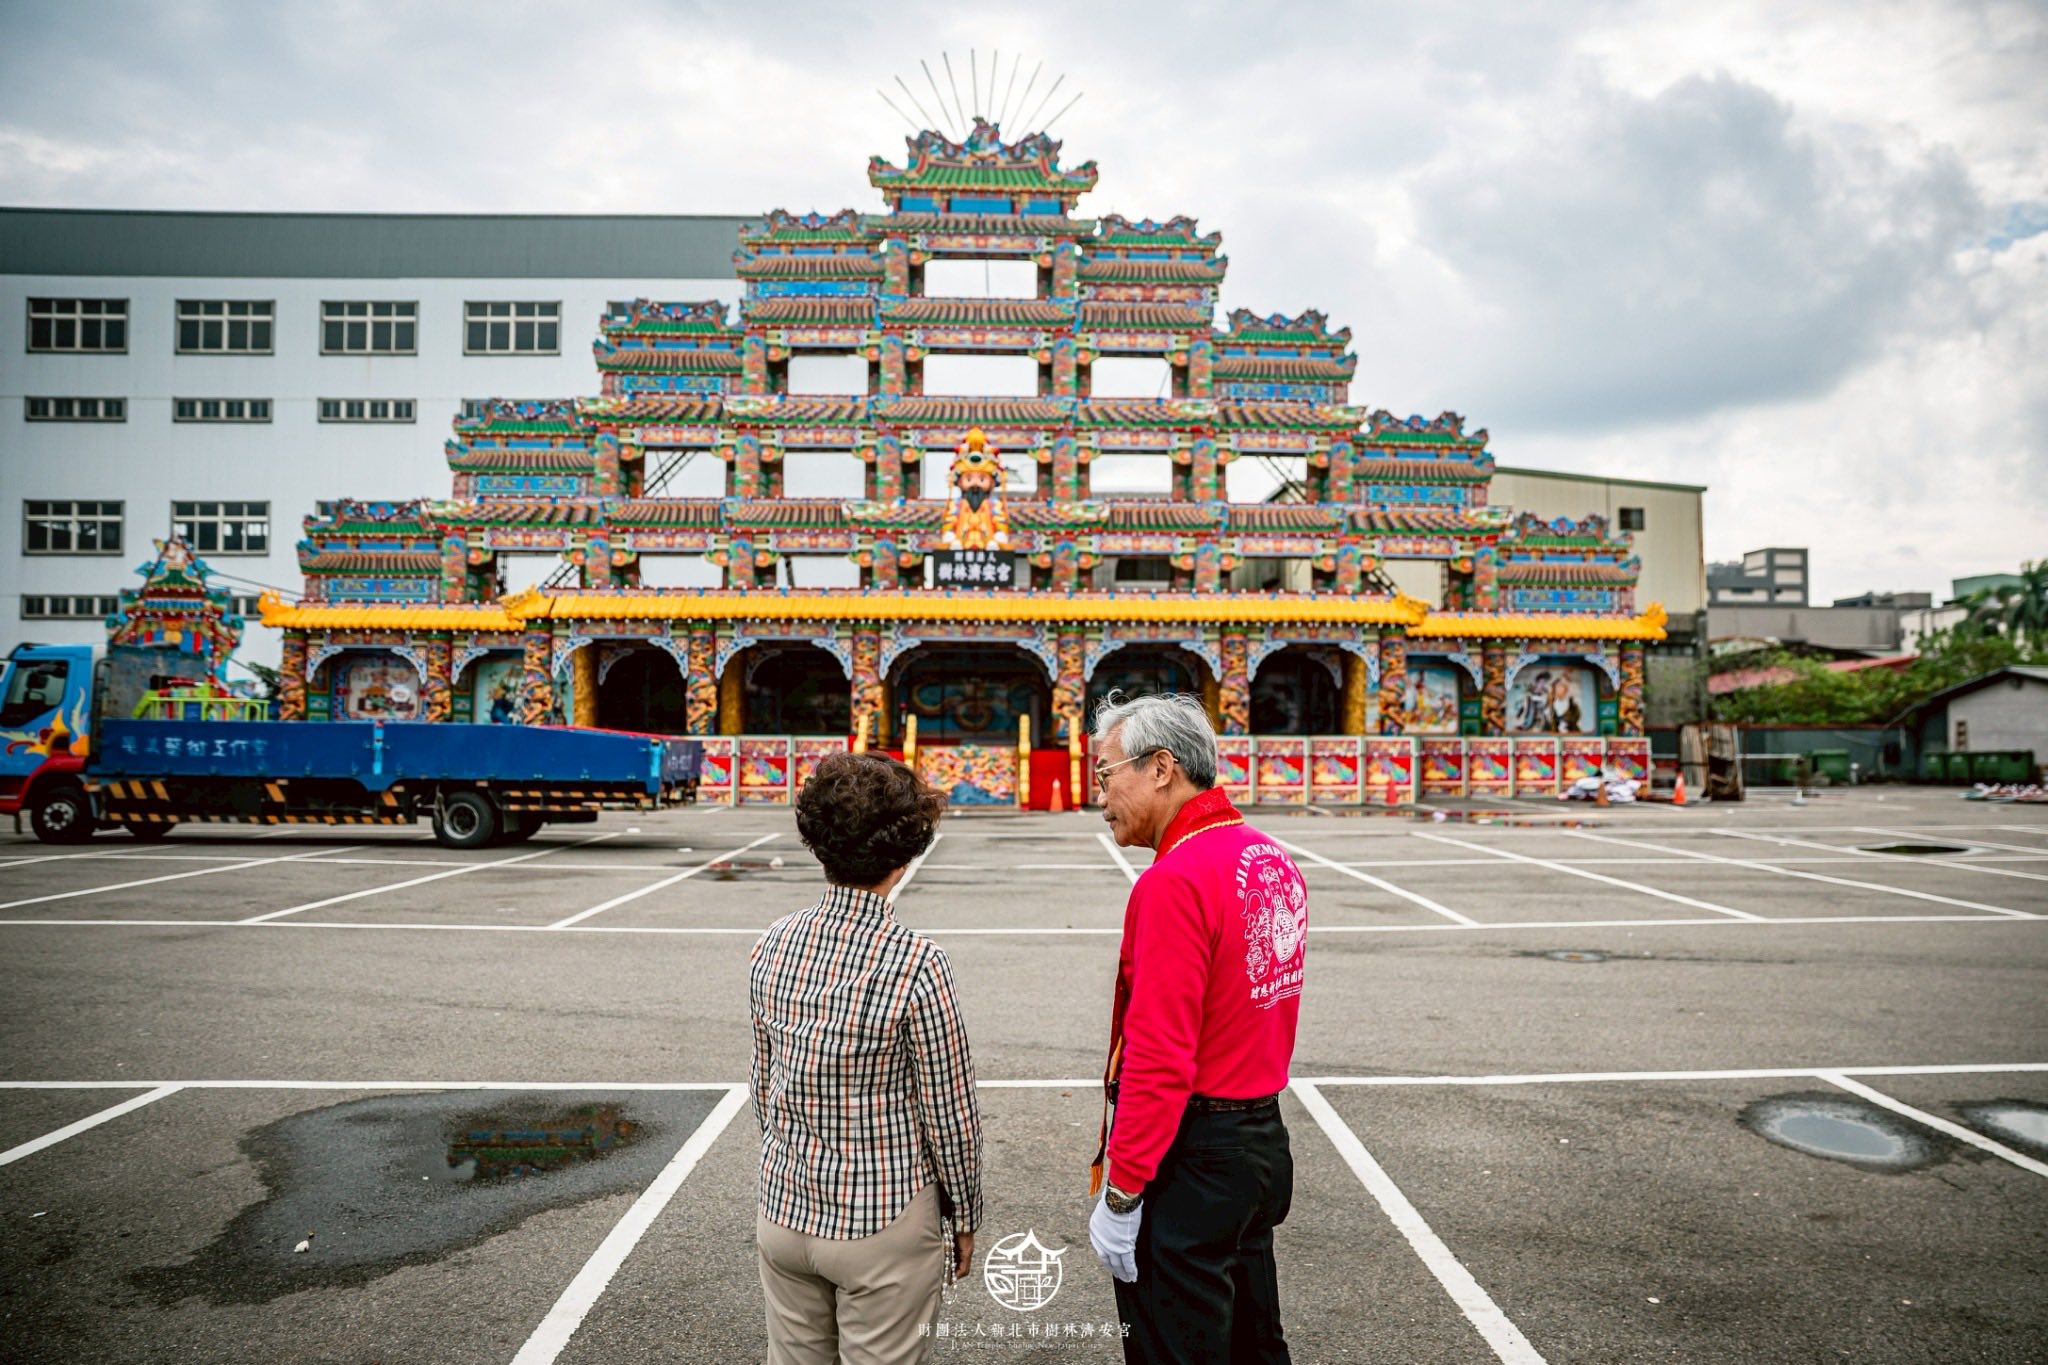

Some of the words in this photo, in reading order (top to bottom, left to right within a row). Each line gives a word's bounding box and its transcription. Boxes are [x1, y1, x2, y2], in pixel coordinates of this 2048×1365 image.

[938, 562, 1012, 582] 樹林濟安宮
